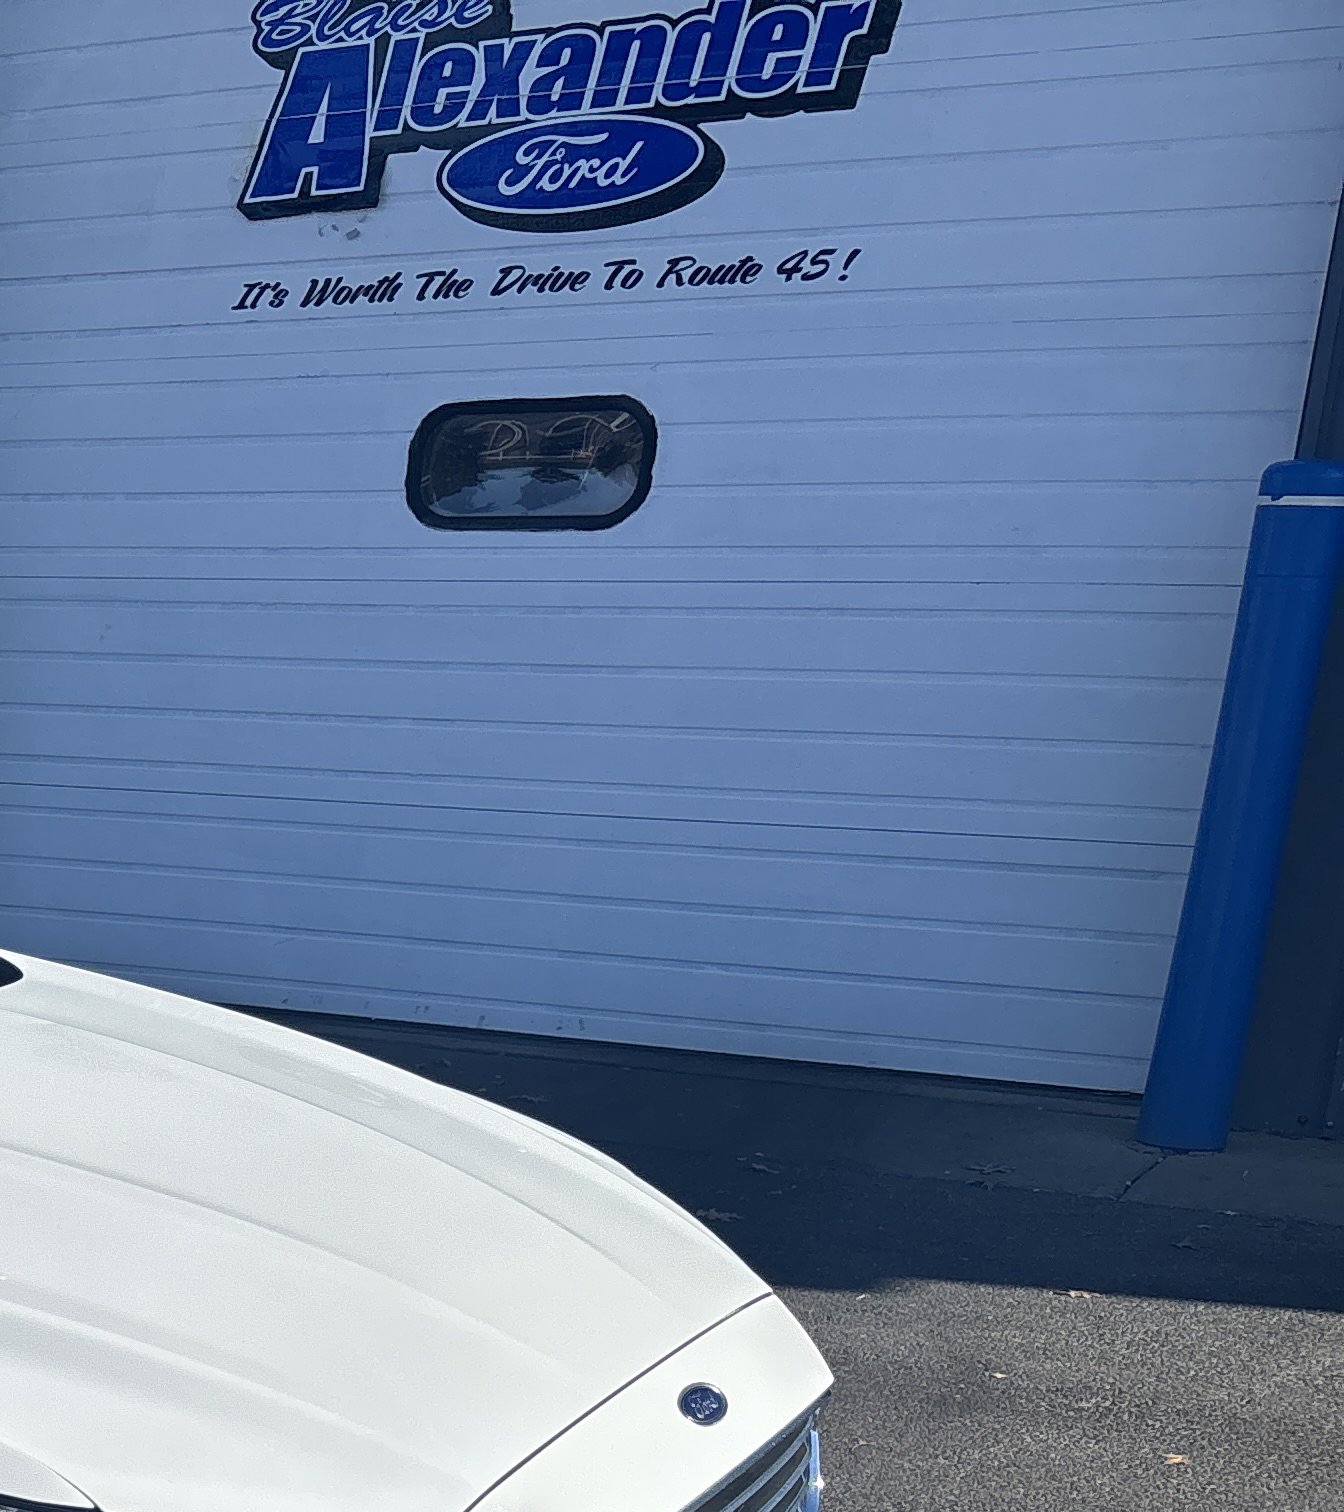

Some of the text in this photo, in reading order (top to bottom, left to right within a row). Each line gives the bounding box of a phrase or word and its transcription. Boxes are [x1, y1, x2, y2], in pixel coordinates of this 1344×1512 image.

[242, 0, 877, 206] Alexander
[497, 135, 645, 196] Ford
[231, 281, 290, 310] It's
[299, 271, 404, 308] Worth
[415, 268, 475, 302] The
[490, 265, 591, 297] Drive
[603, 258, 645, 291] To
[656, 255, 763, 289] Route
